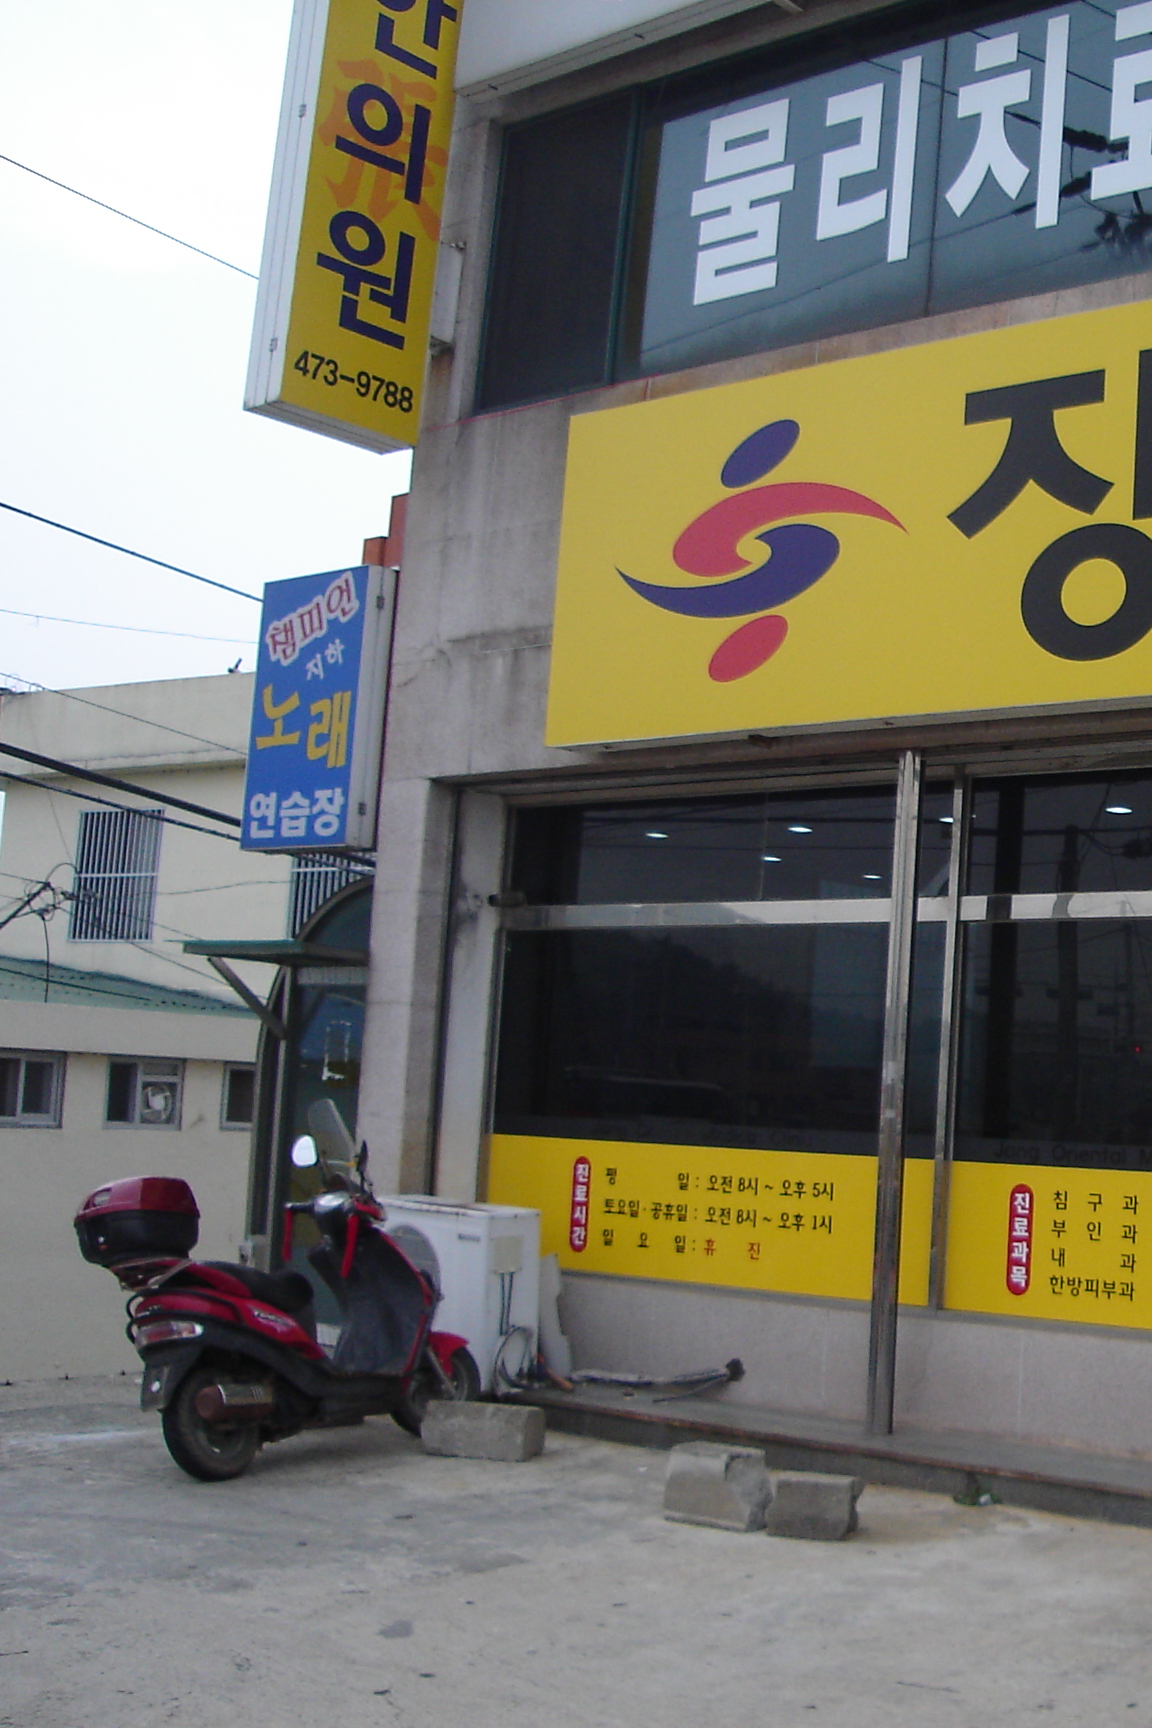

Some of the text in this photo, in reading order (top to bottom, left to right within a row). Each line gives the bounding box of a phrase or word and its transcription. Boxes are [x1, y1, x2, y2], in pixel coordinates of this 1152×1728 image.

[294, 350, 414, 413] 473-9788
[267, 574, 357, 664] 챔피언
[306, 639, 346, 681] 지하
[255, 683, 351, 769] 노래
[249, 787, 344, 839] 연습장
[707, 1175, 732, 1194] 오전
[779, 1180, 807, 1199] 오후
[705, 1206, 731, 1225] 오전
[778, 1212, 804, 1231] 오후
[1011, 1193, 1030, 1287] 진료과목
[1049, 1276, 1135, 1301] 한방피부과
